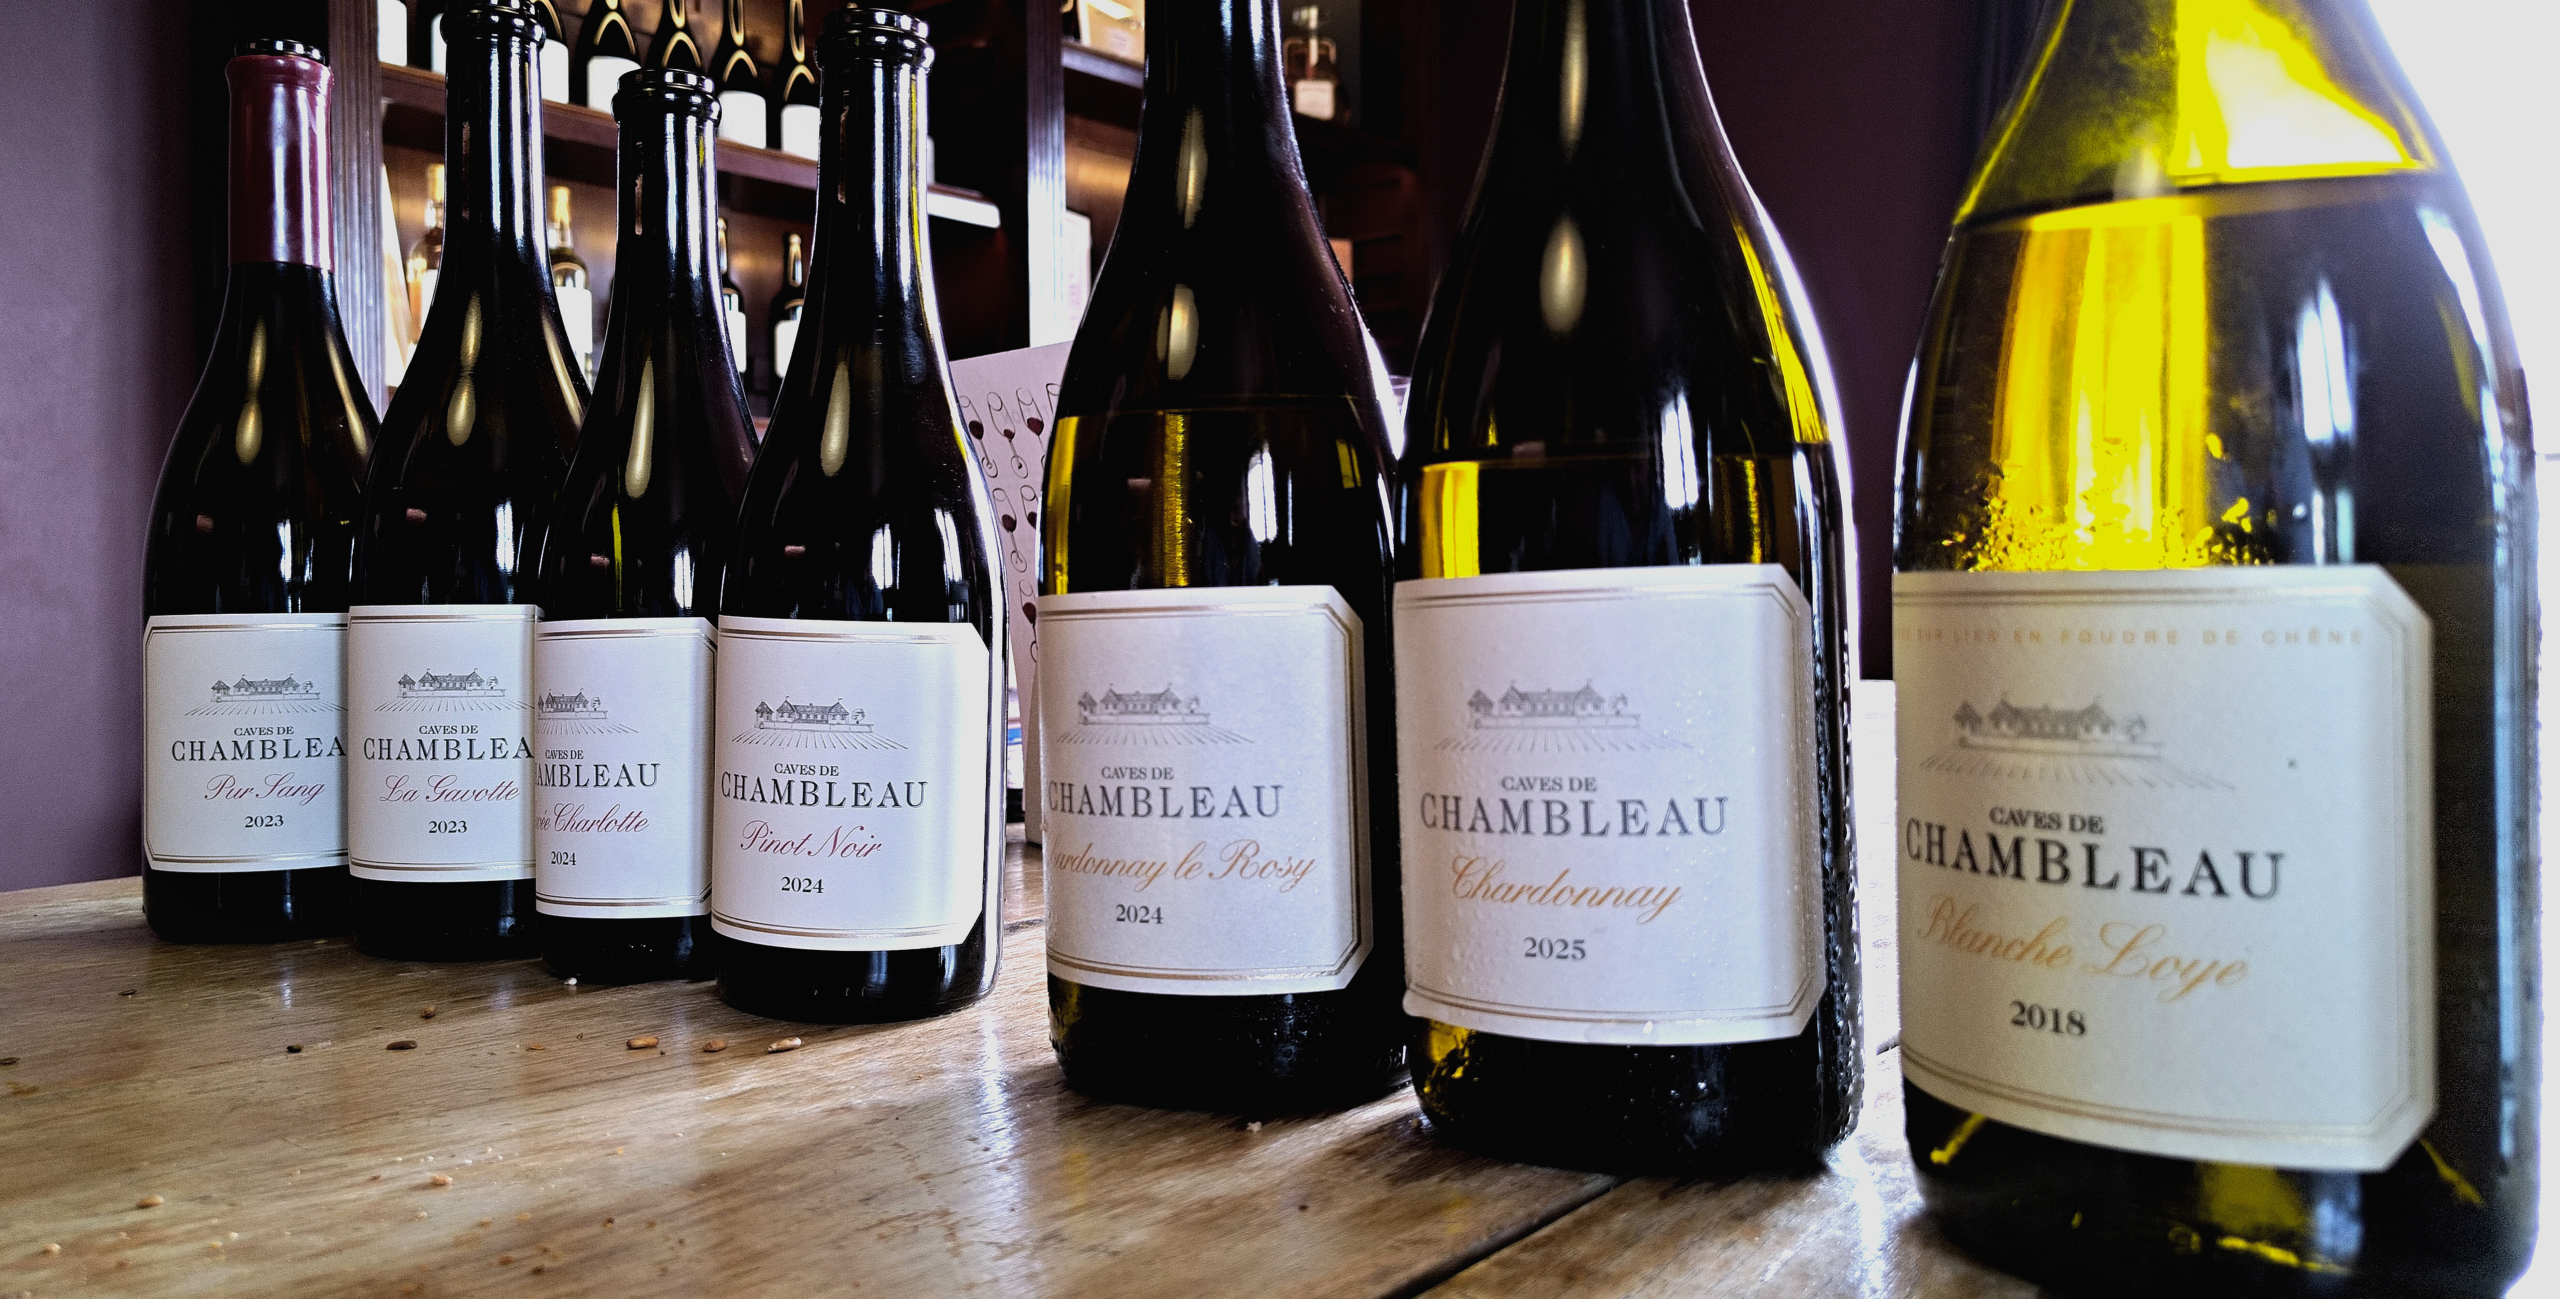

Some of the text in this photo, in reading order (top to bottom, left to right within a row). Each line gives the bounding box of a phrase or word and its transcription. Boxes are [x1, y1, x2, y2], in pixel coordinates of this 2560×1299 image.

[2013, 629, 2041, 644] EN
[2060, 629, 2178, 644] FOUDRE
[2202, 629, 2238, 644] DE
[2261, 626, 2362, 644] CHÊNE
[234, 725, 294, 738] CAVES DE
[419, 724, 479, 736] CAVES DE
[171, 737, 347, 762] CHAMBLEA
[363, 737, 535, 762] CHAMBLEA
[545, 750, 584, 760] CAVES DE
[536, 763, 660, 788] AMBLEAU
[774, 763, 840, 777] CAVES DE
[1101, 766, 1174, 781] CAVES DE
[204, 771, 326, 806] Pur Sang
[380, 774, 520, 802] La Gavotte
[721, 771, 928, 808] CHAMBLEAU
[1501, 776, 1597, 793] CAVES DE
[1048, 780, 1284, 819] CHAMBLEAU
[244, 815, 284, 828] 2023
[428, 820, 468, 834] 2023
[554, 802, 650, 833] Charlotte
[1420, 792, 1729, 837] CHAMBLEAU
[1989, 805, 2104, 836] CAVES DE
[740, 820, 882, 860] Pinot Noir
[551, 851, 577, 867] 2024
[1174, 840, 1204, 881] le
[1209, 838, 1316, 893] Rosy
[1906, 817, 2285, 900] CHAMBLEAU
[781, 876, 824, 895] 2024
[1451, 855, 1683, 924] Chardonnay
[1116, 904, 1164, 924] 2024
[1523, 936, 1587, 960] 2025
[1917, 892, 2250, 1003] Blanche Loye
[2009, 1000, 2086, 1037] 2018
